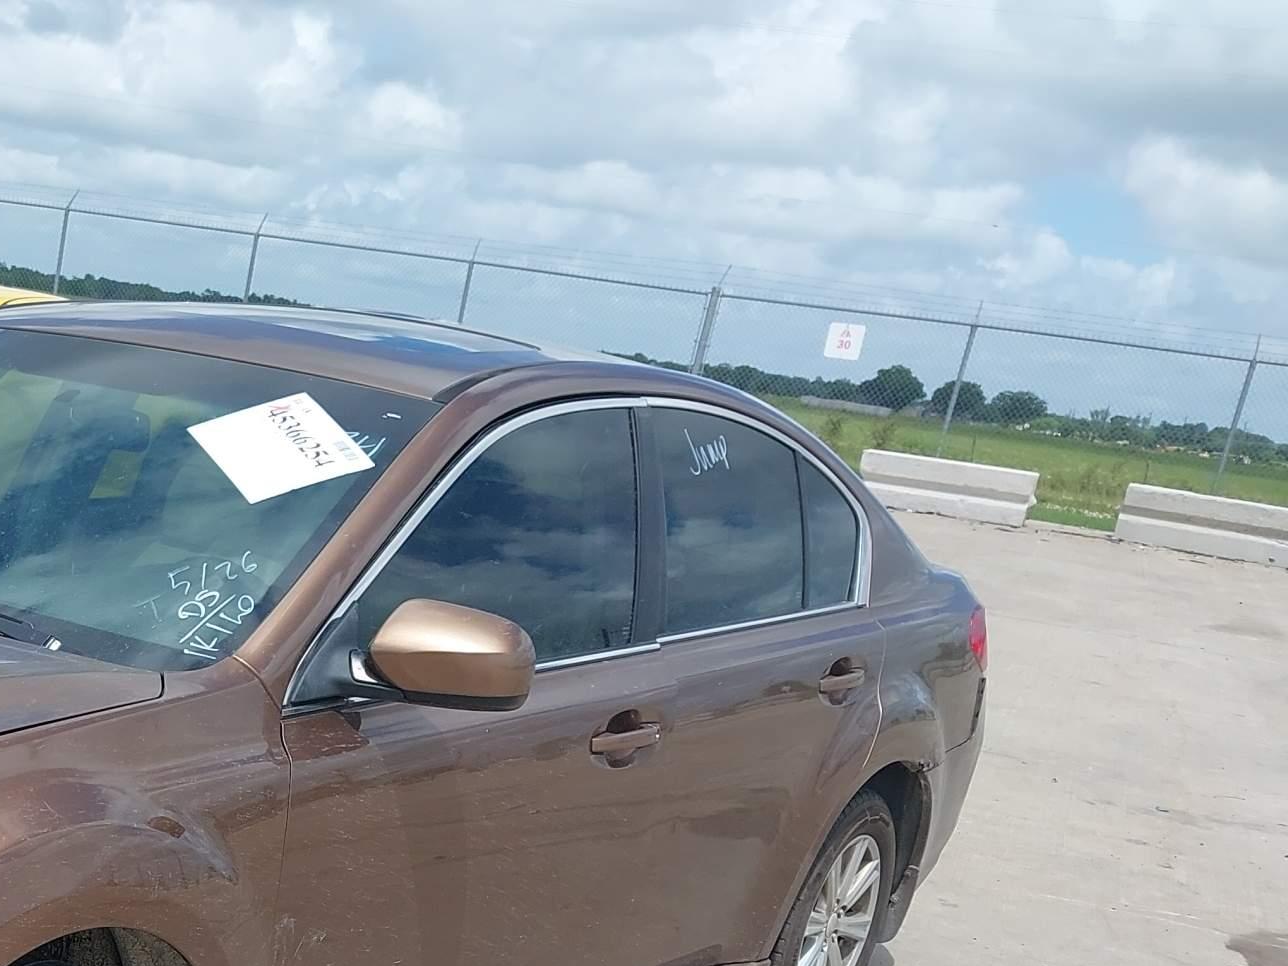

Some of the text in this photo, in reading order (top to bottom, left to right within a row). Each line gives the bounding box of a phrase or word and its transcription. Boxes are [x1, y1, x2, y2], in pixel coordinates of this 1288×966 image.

[835, 339, 852, 350] 30
[268, 410, 335, 467] 45366254
[684, 428, 730, 475] Jump
